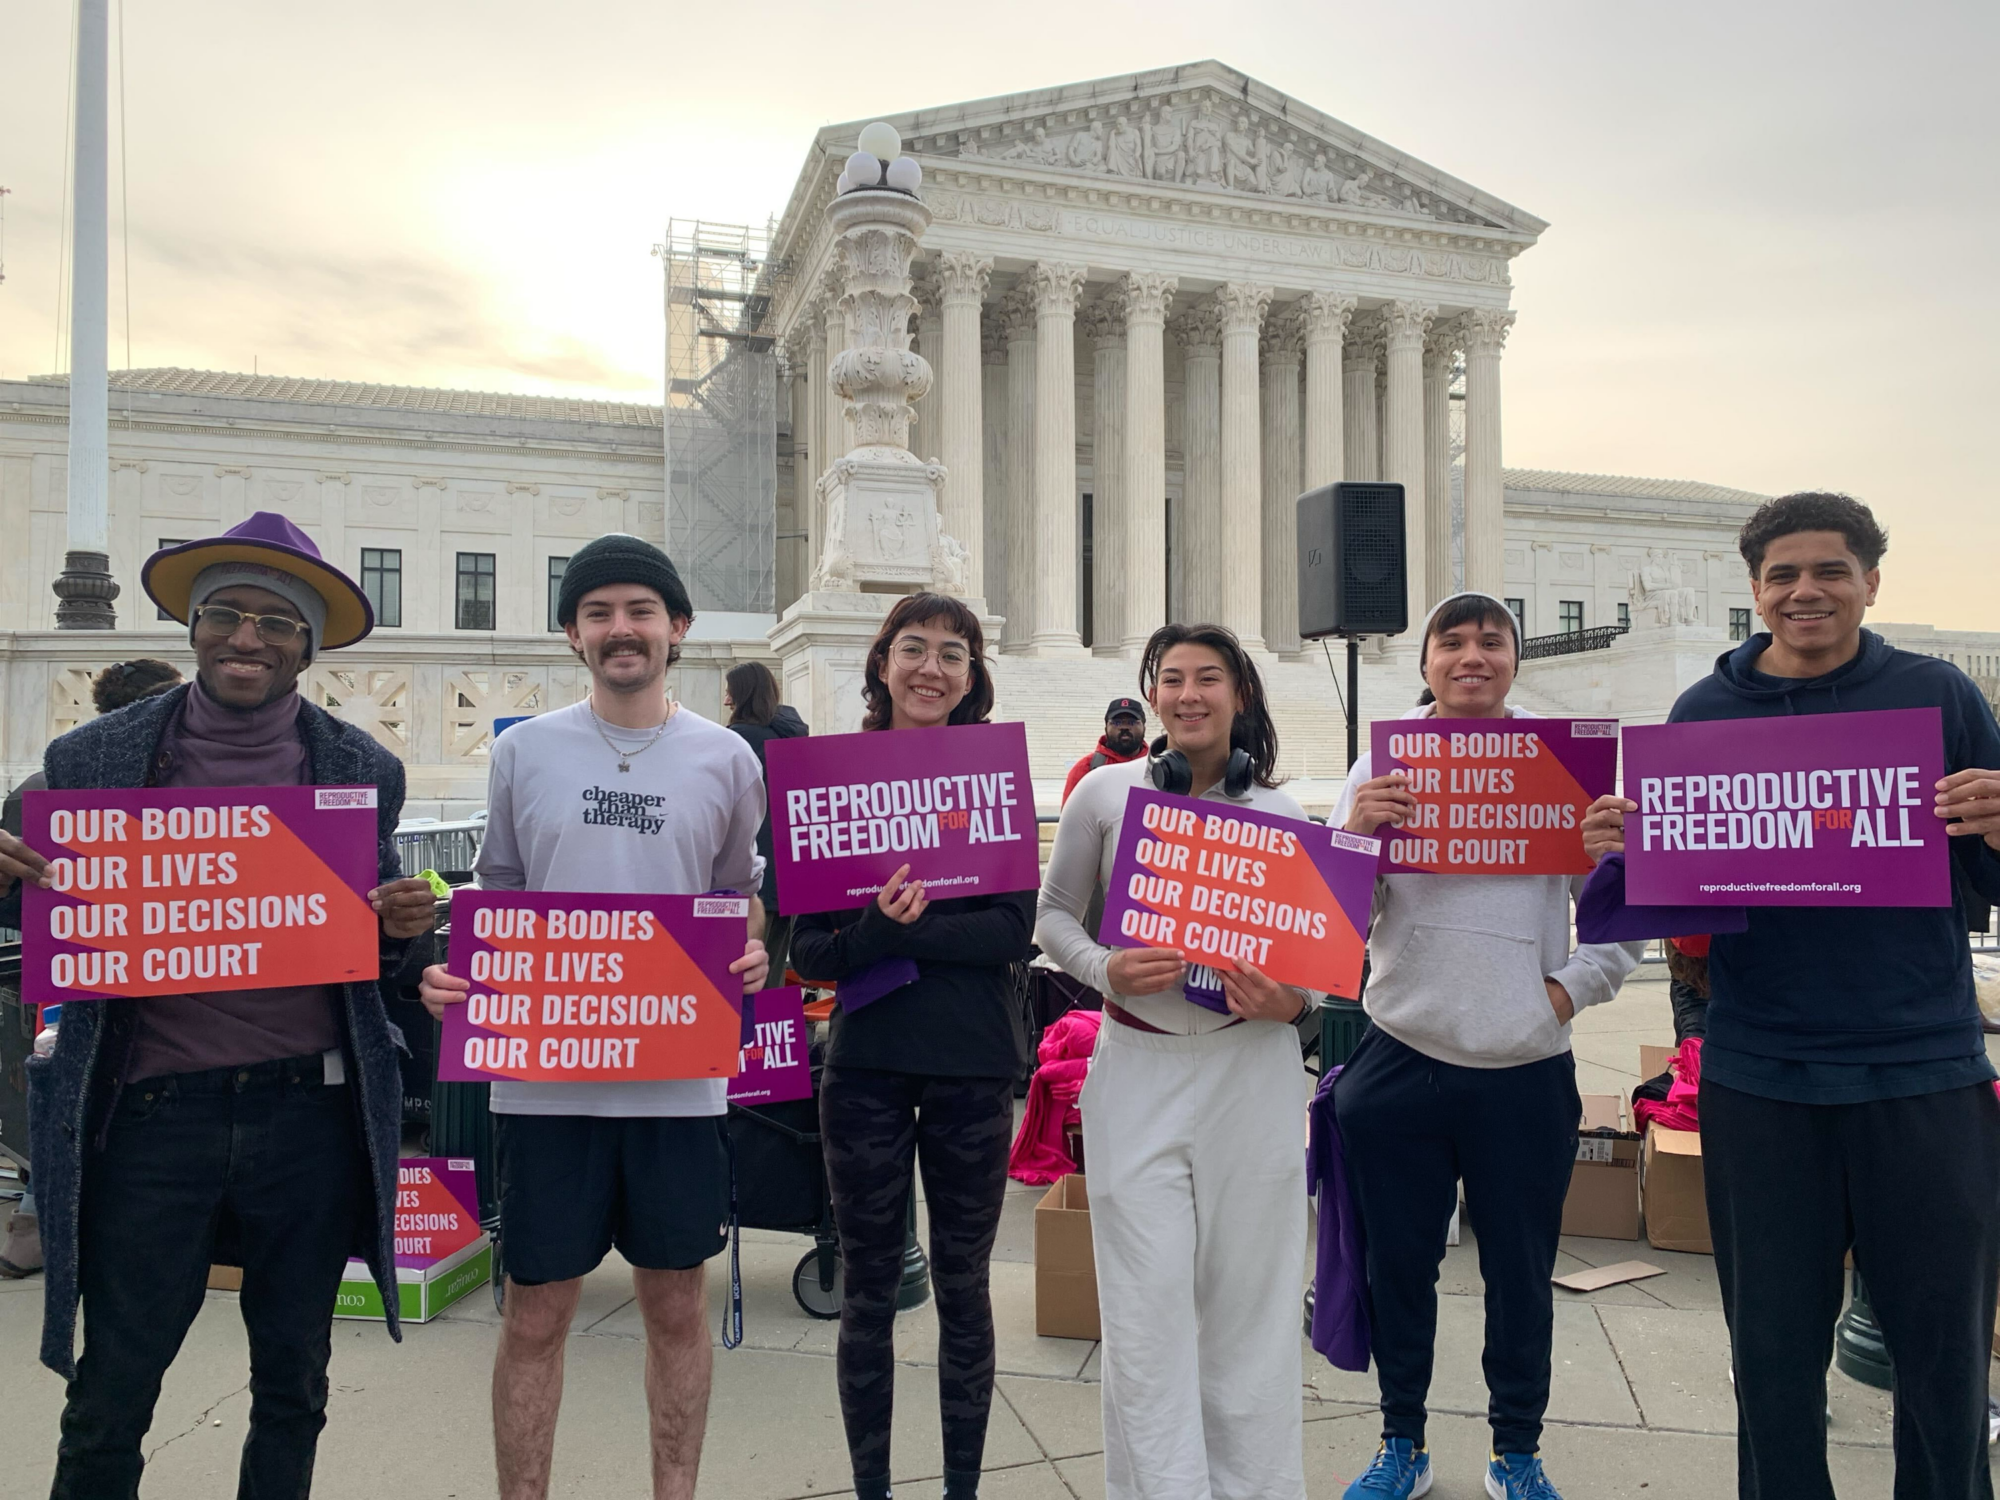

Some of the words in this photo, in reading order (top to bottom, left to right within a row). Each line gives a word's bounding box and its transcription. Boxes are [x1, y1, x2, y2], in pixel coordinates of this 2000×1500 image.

[1074, 216, 1138, 238] EQUAL
[1143, 224, 1214, 247] JUSTICE
[1223, 233, 1283, 255] UNDER
[1289, 241, 1323, 258] LAW
[1389, 733, 1440, 758] OUR
[1450, 733, 1538, 758] BODIES
[582, 785, 666, 808] cheaper
[1450, 768, 1514, 793] LIVES
[1641, 766, 1922, 813] REPRODUCTIVE
[597, 800, 646, 816] than
[787, 772, 1018, 825] REPRODUCTIVE
[50, 809, 128, 843] OUR
[142, 804, 271, 841] BODIES
[582, 807, 666, 835] therapy
[1142, 803, 1197, 837] OUR
[1203, 814, 1298, 858] BODIES
[1449, 804, 1575, 829] DECISIONS
[1642, 810, 1814, 851] FREEDOM
[1814, 809, 1853, 829] FOR
[1850, 807, 1924, 848] ALL
[790, 813, 940, 862] FREEDOM
[939, 811, 969, 830] FOR
[968, 807, 1022, 845] ALL
[1389, 839, 1438, 864] OUR
[1449, 839, 1529, 864] COURT
[51, 856, 128, 892] OUR
[142, 851, 238, 888] LIVES
[1134, 837, 1190, 872] OUR
[1197, 849, 1267, 887] LIVES
[1699, 882, 1862, 893] reproductivefreedomforall.org
[50, 903, 128, 940] OUR
[142, 893, 328, 935] DECISIONS
[1127, 873, 1184, 908] OUR
[1190, 884, 1328, 940] DECISIONS
[473, 907, 536, 939] OUR
[547, 909, 654, 941] BODIES
[1120, 909, 1177, 945] OUR
[1183, 921, 1273, 966] COURT
[51, 951, 128, 988] OUR
[142, 942, 263, 982] COURT
[470, 950, 533, 983] OUR
[544, 951, 624, 983] LIVES
[466, 993, 532, 1026] OUR
[541, 994, 697, 1026] DECISIONS
[463, 1037, 529, 1069] OUR
[539, 1037, 640, 1069] COURT
[745, 1047, 764, 1061] FOR
[763, 1043, 799, 1070] ALL
[445, 1268, 479, 1298] cougar
